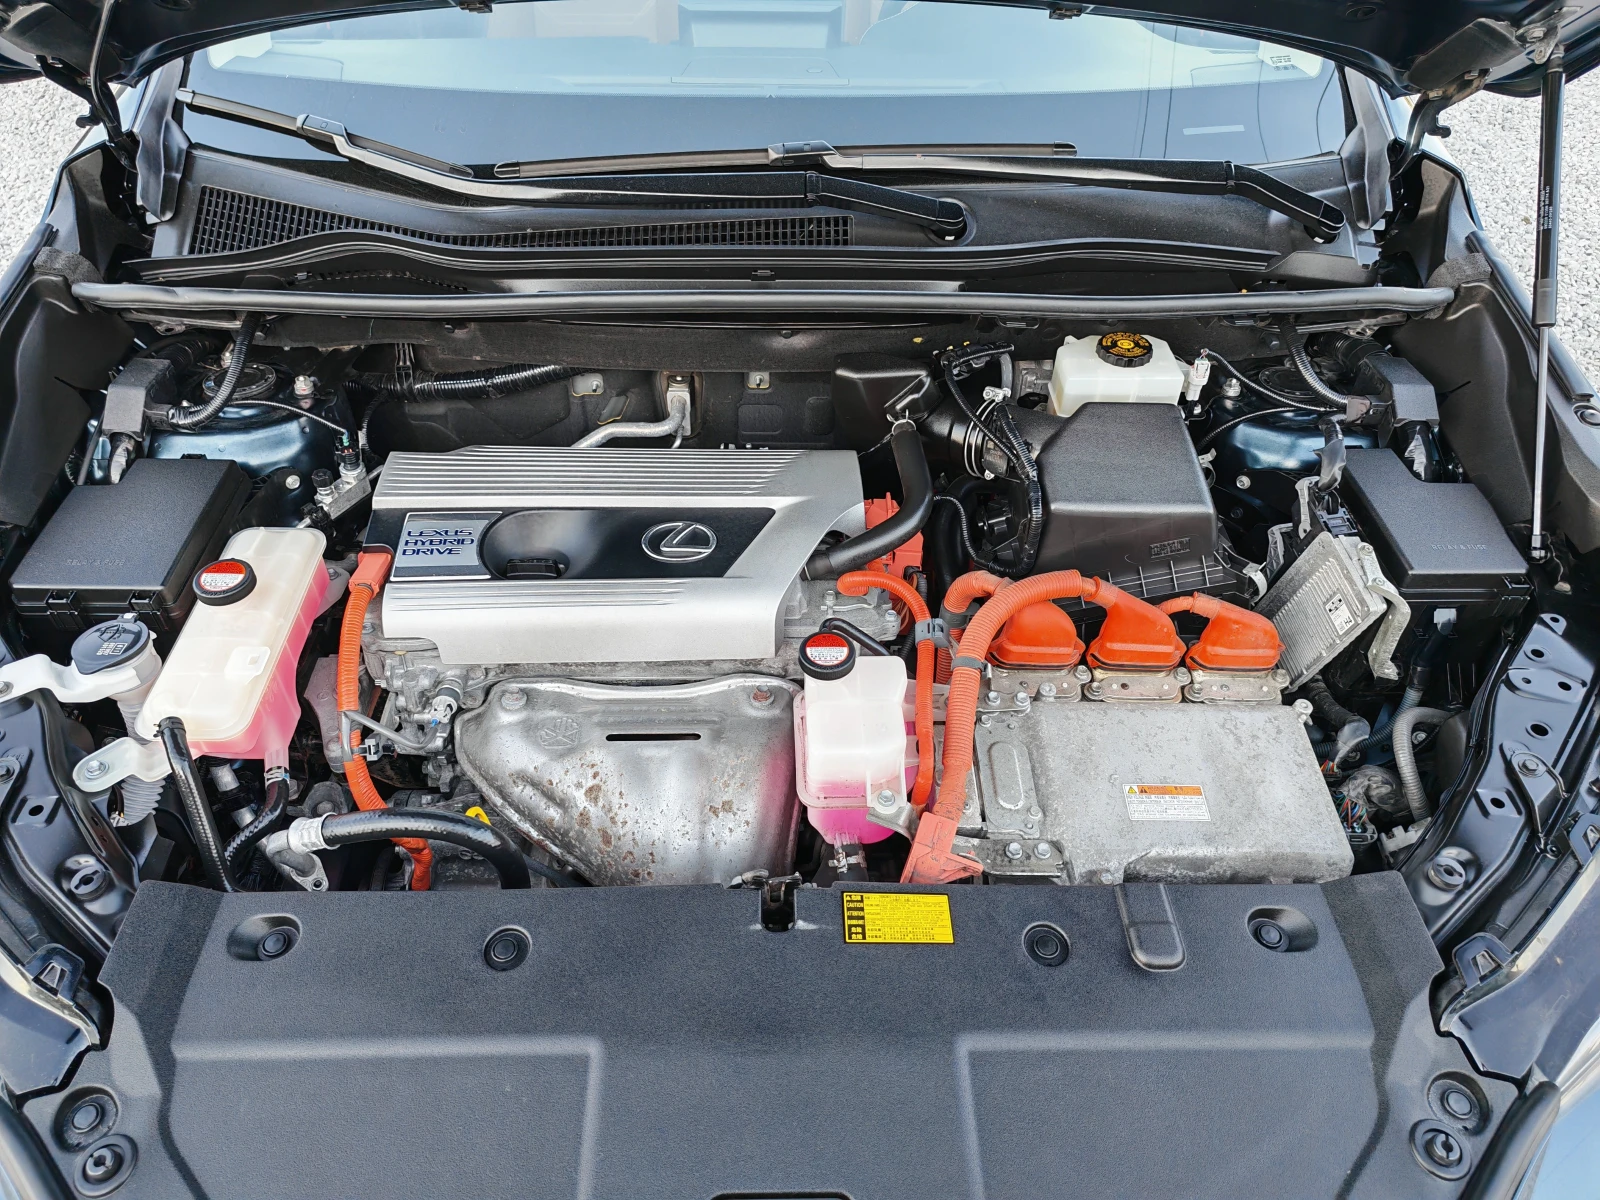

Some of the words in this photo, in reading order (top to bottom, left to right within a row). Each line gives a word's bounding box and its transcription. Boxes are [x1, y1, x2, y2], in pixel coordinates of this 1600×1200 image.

[407, 527, 473, 537] LEXUS
[404, 537, 475, 547] HYBRID
[402, 547, 462, 556] DRIVE
[1430, 543, 1457, 551] RELAY
[1467, 543, 1487, 551] FUSE
